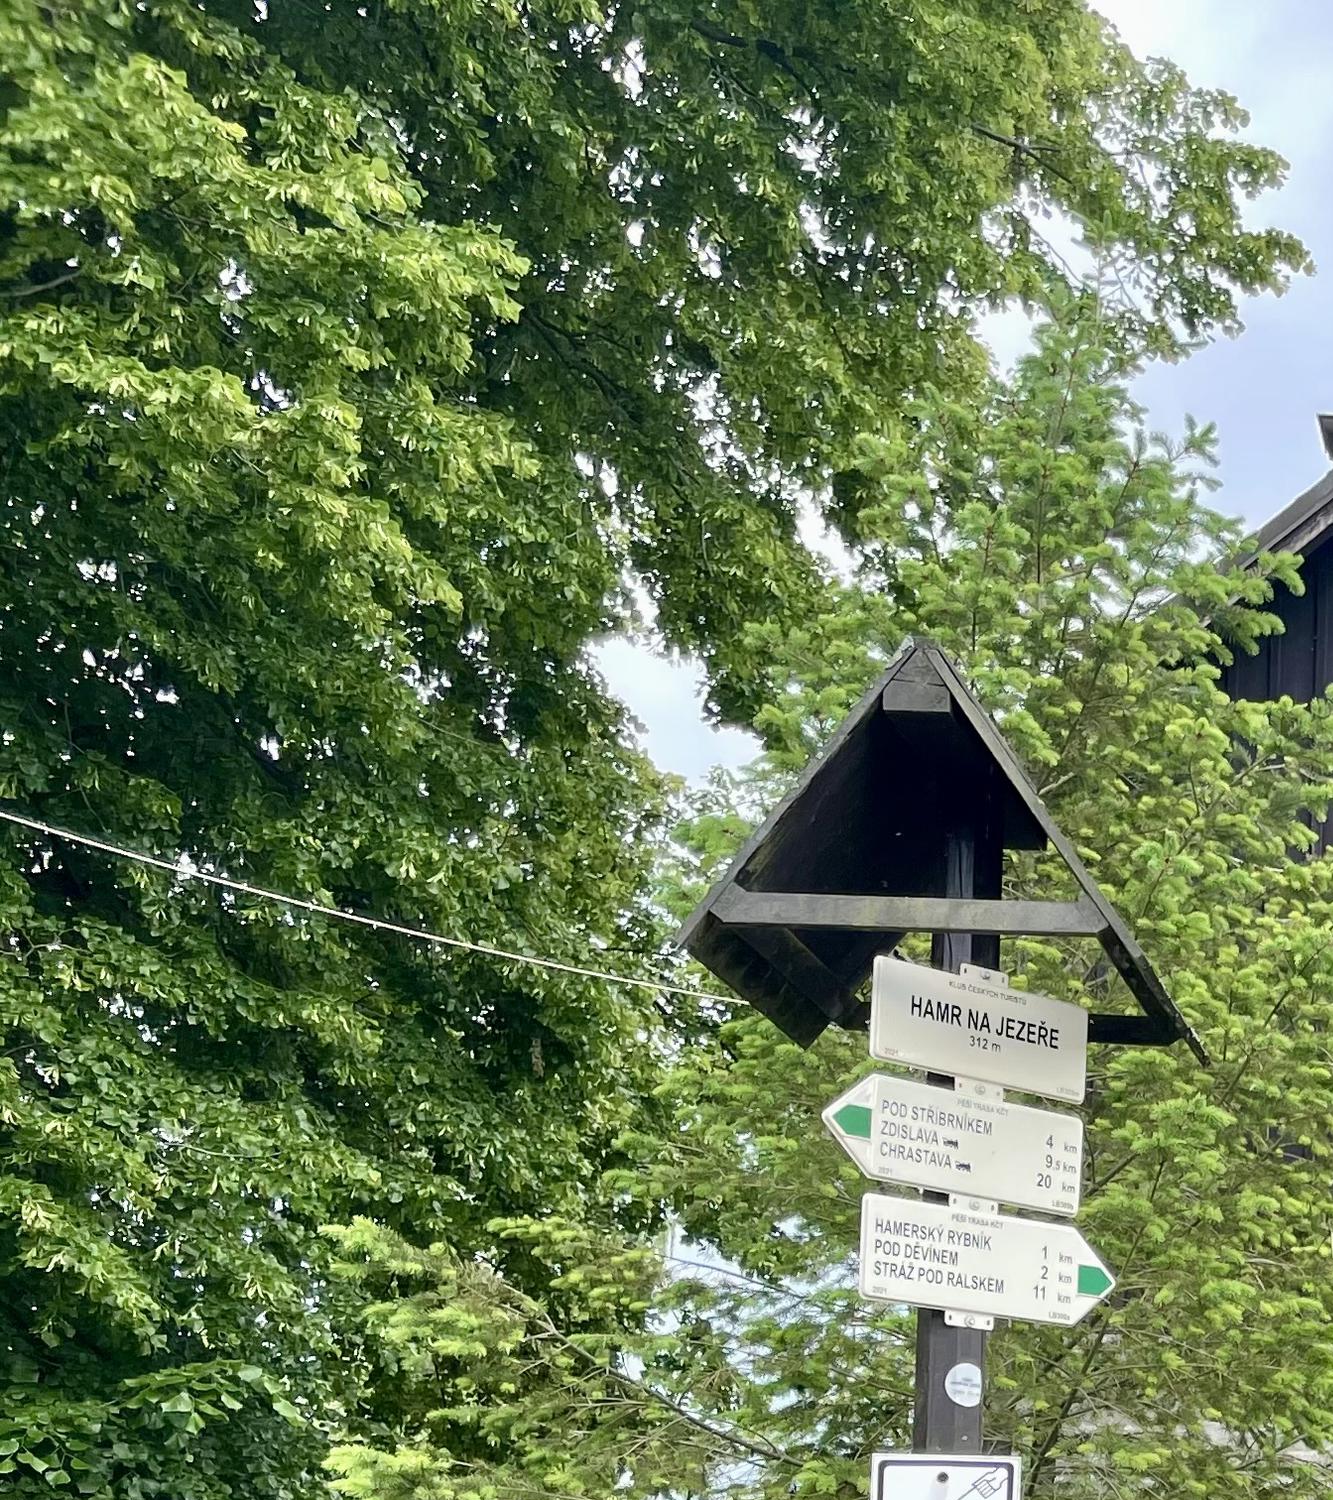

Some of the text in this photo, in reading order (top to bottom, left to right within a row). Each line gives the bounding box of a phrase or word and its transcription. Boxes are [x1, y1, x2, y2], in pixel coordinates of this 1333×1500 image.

[911, 995, 1059, 1050] HAMR NA JEZEŘE
[969, 1035, 1002, 1053] 312 m
[882, 1100, 993, 1136] POD STŘÍBRNÍKEM
[880, 1120, 939, 1146] ZDISLAVA
[1045, 1135, 1078, 1154] 4 km
[879, 1142, 951, 1169] CHRASTAVA
[1063, 1159, 1077, 1174] km
[1037, 1173, 1076, 1194] 20 km
[875, 1218, 992, 1251] HAMERSKÝ RYBNÍK
[874, 1239, 959, 1266] POD DĚVÍNEM
[1042, 1246, 1073, 1265] 1 km
[874, 1259, 1004, 1294] STRÁŽ POD RALSKEM
[1040, 1266, 1072, 1284] 2 km
[1033, 1285, 1072, 1305] 11 km
